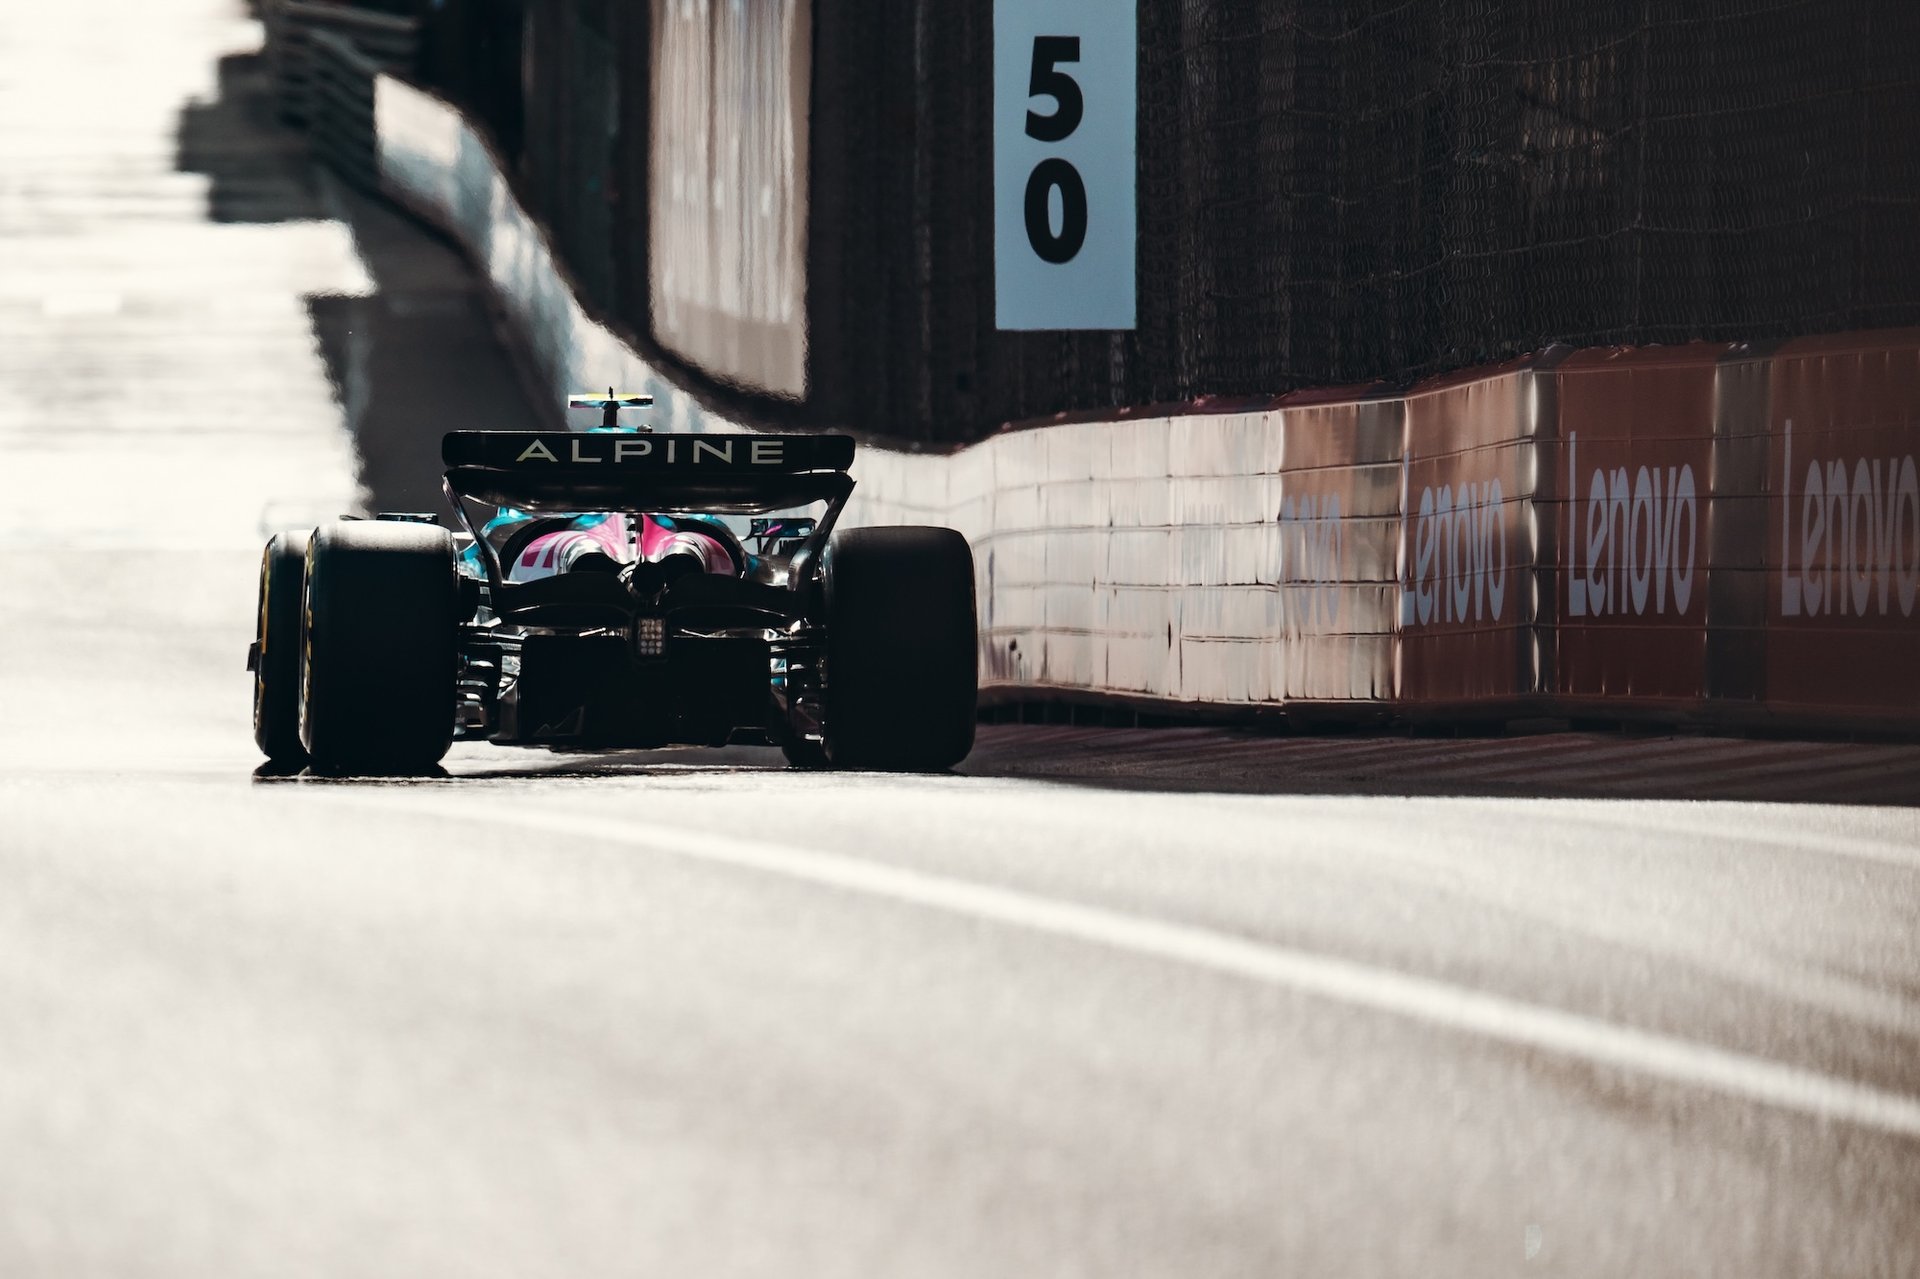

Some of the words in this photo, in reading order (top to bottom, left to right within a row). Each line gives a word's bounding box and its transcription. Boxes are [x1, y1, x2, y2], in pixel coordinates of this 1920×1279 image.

[1024, 36, 1088, 265] 50
[516, 438, 784, 465] ALPINE
[1401, 450, 1506, 627] Lenovo
[1568, 430, 1697, 618] Lenovo
[1781, 418, 1920, 618] Lenovo
[1267, 490, 1343, 627] novo
